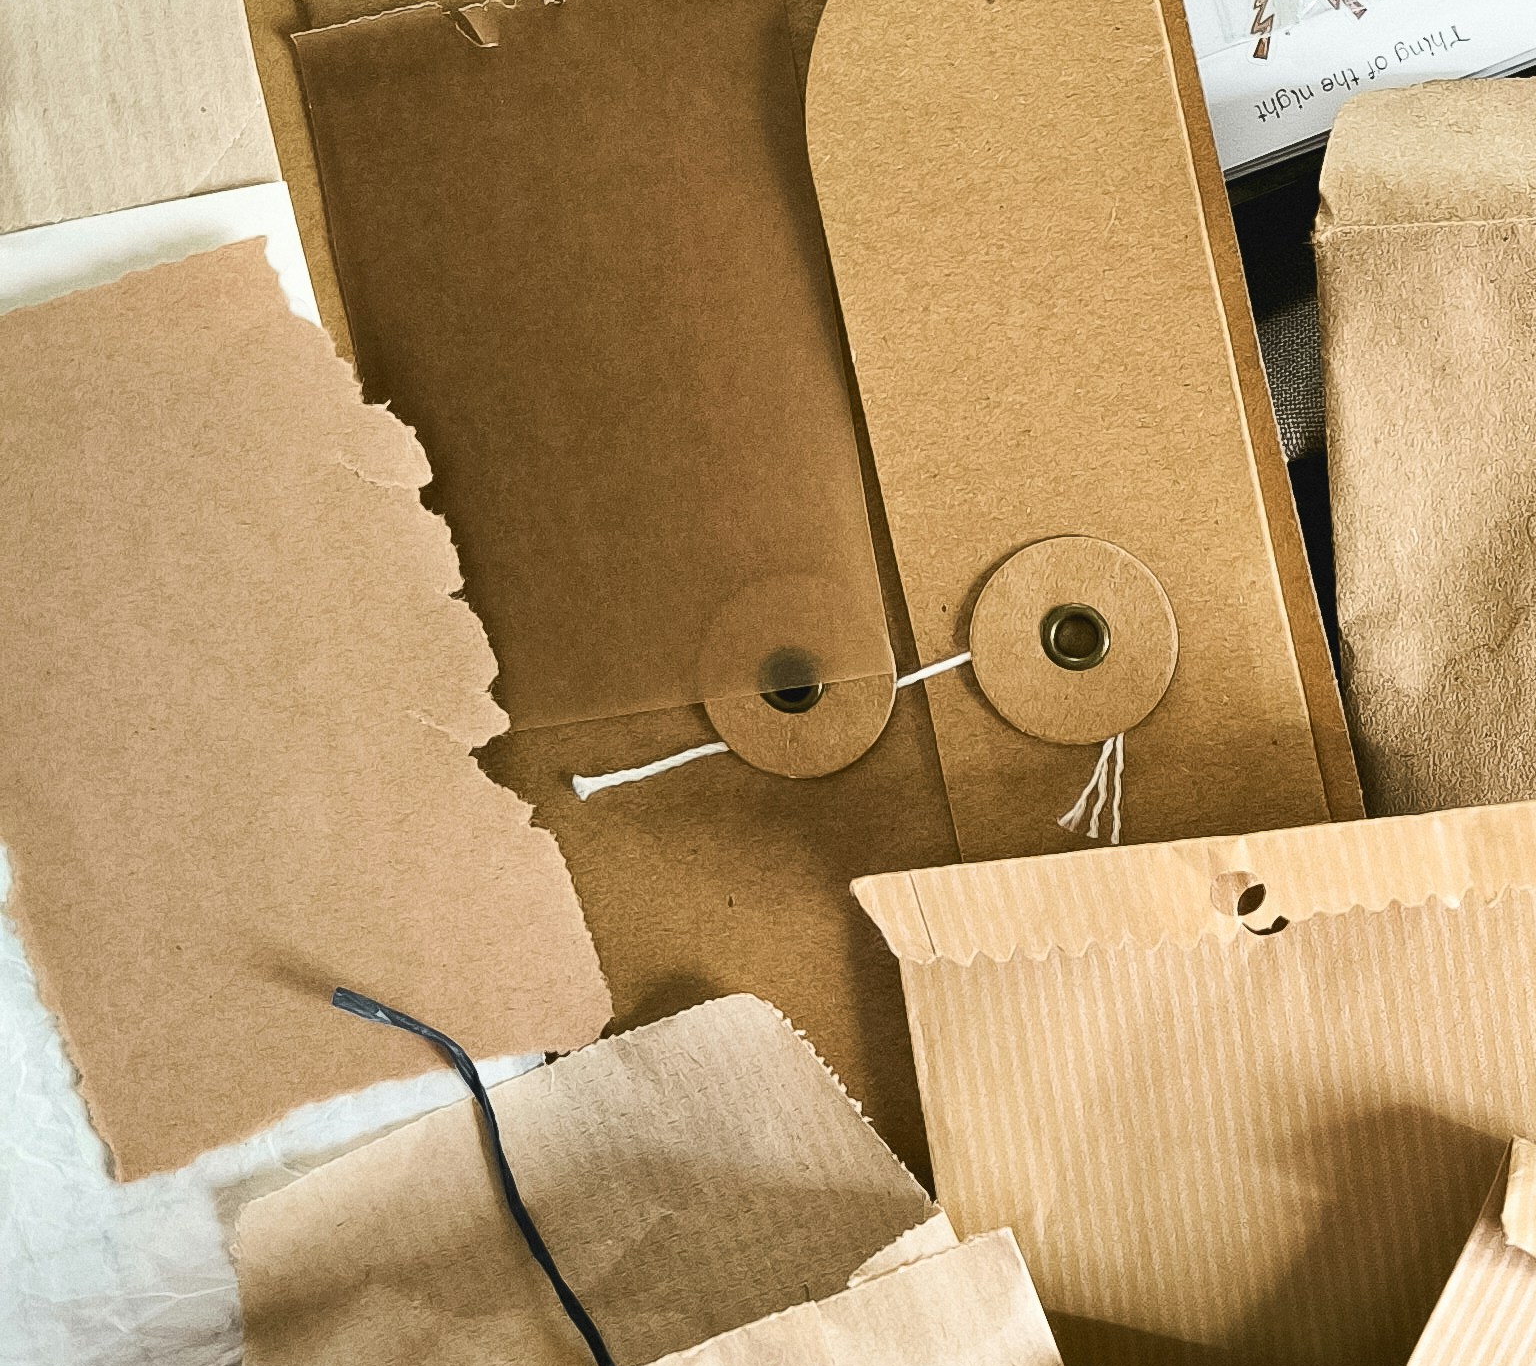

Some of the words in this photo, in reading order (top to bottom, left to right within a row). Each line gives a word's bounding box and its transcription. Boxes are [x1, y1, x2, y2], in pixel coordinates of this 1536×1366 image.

[1394, 24, 1471, 63] Thing
[1320, 69, 1360, 95] the
[1365, 57, 1389, 82] of
[1253, 84, 1316, 123] night
